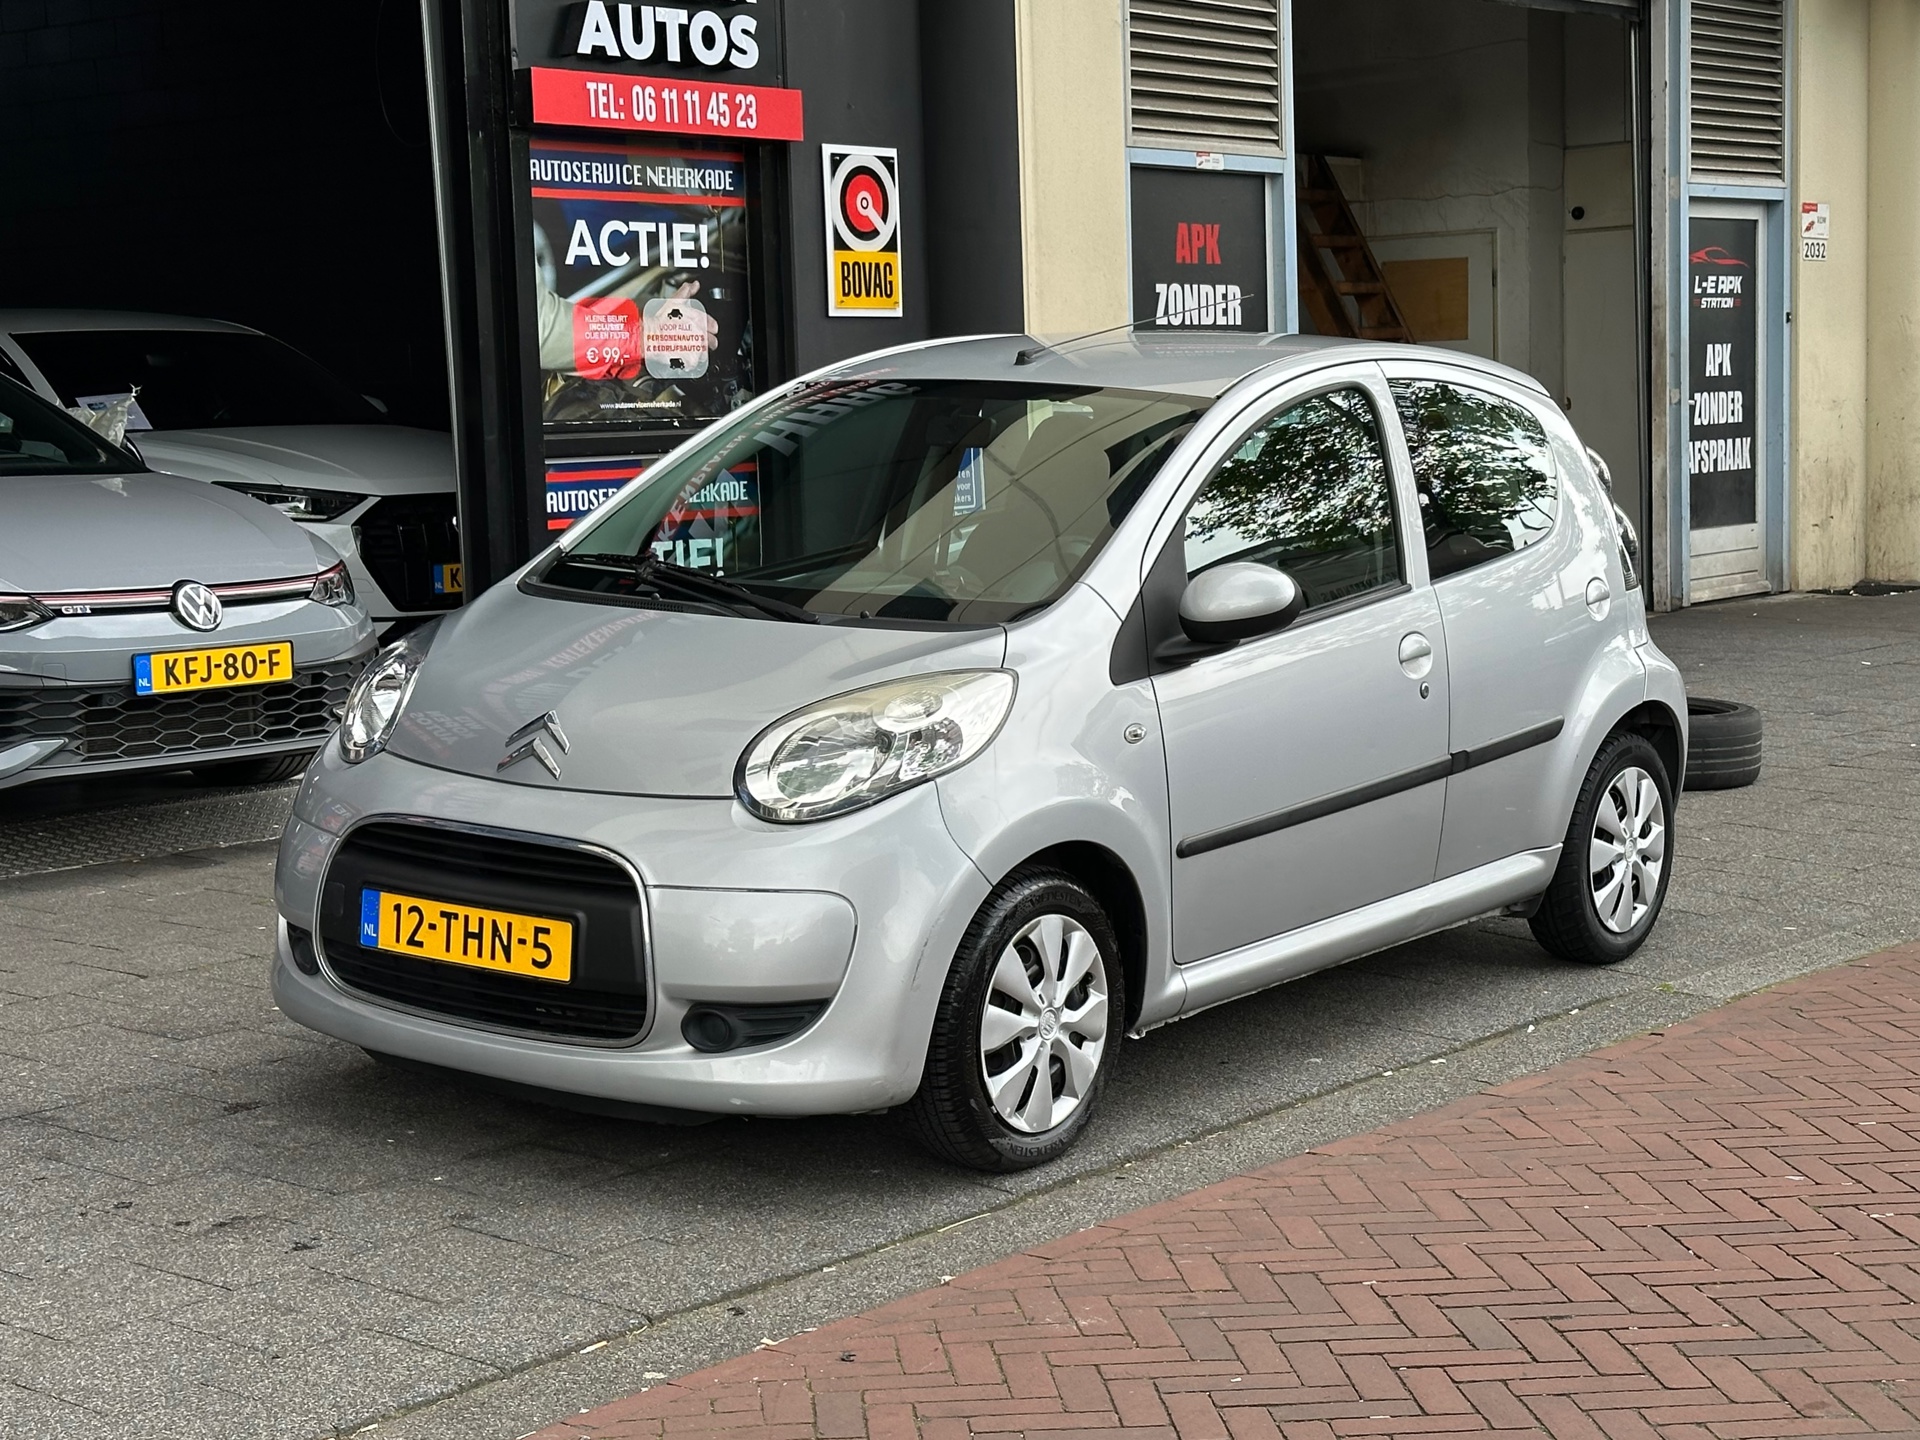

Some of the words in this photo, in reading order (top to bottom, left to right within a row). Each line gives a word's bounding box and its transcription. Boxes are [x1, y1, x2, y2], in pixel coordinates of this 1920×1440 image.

[577, 0, 759, 69] AUTOS
[586, 81, 625, 120] TEL:
[631, 84, 657, 122] 06
[661, 87, 679, 124] 11
[684, 89, 701, 125] 11
[706, 91, 730, 128] 45
[735, 92, 758, 130] 23
[530, 159, 643, 186] AUTOSERVICE
[646, 165, 734, 191] NEHERKADE
[565, 219, 710, 269] ACTIE!
[1175, 222, 1222, 265] APK
[1804, 242, 1826, 259] 2032
[841, 261, 893, 298] BOVAG
[1694, 275, 1717, 294] L-E
[1717, 275, 1743, 294] APK
[1155, 283, 1242, 326] ZONDER
[1700, 297, 1734, 309] STATION
[646, 334, 705, 342] PERSONENAUTO'S
[1705, 343, 1732, 377] APK
[1693, 390, 1743, 426] ZONDER
[61, 604, 92, 615] GTI
[138, 678, 151, 687] NL
[164, 648, 282, 687] KFJ-80-F
[364, 922, 378, 938] NL
[393, 902, 553, 970] 12-THN-5
